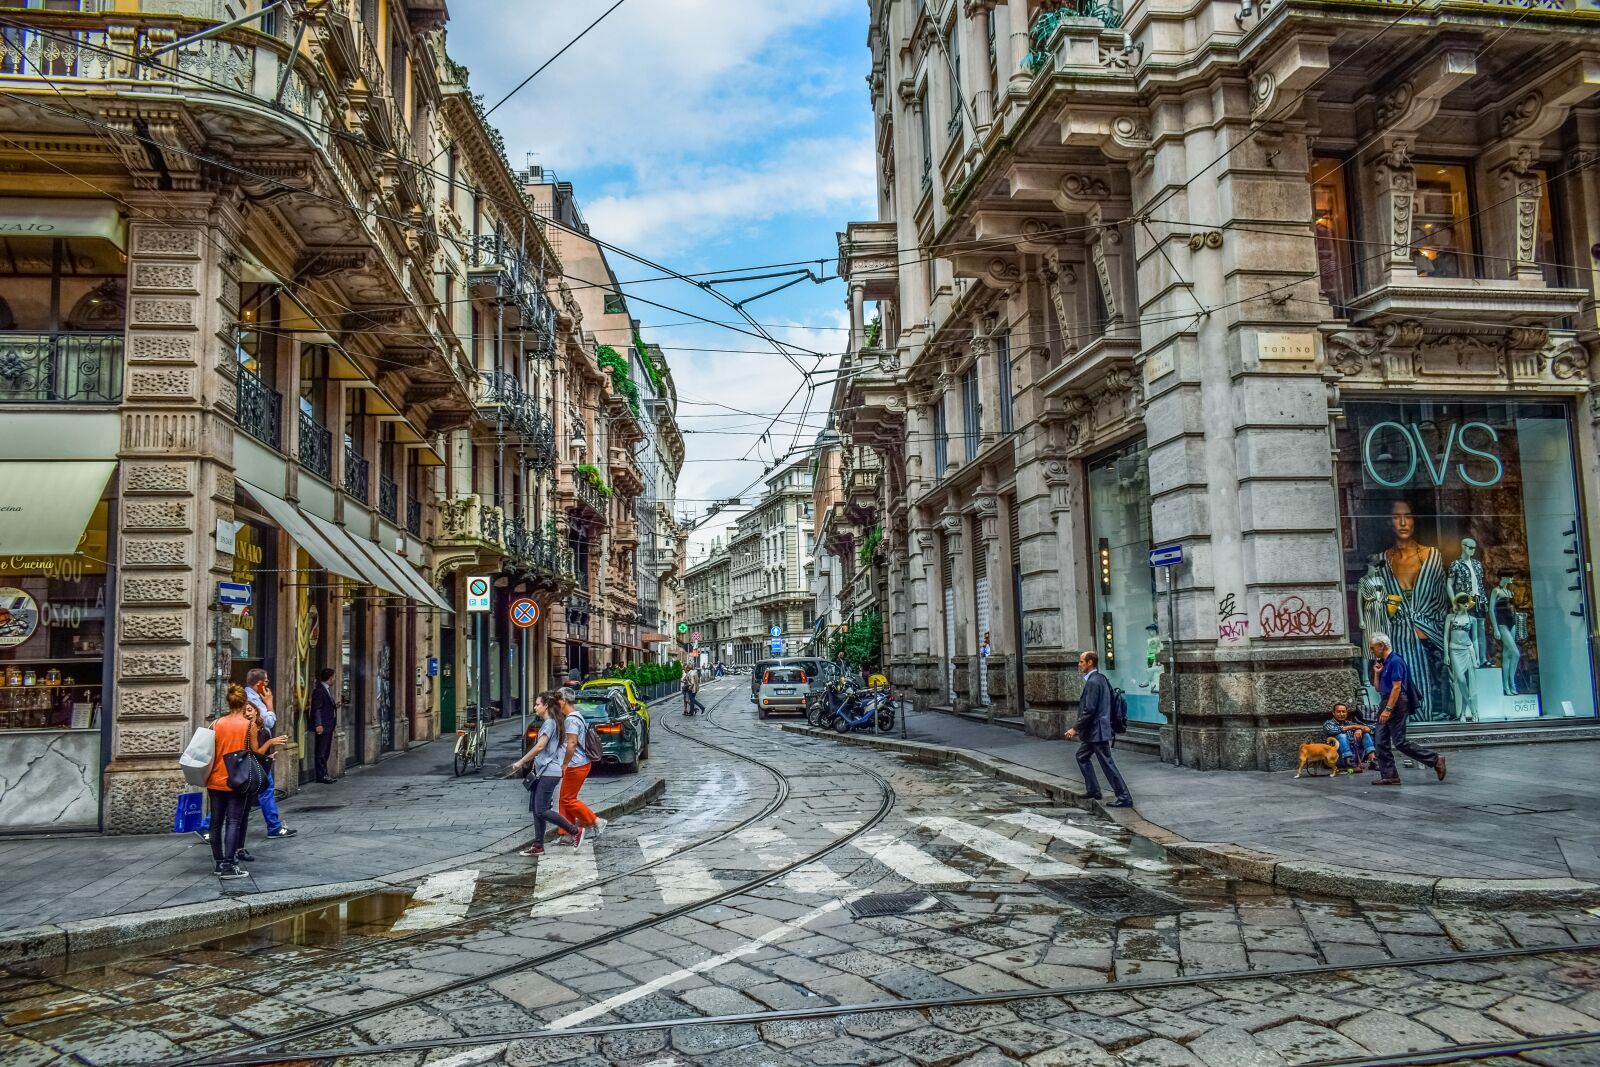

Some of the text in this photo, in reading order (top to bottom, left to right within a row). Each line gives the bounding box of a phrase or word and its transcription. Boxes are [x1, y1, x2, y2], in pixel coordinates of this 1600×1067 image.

[1263, 346, 1311, 354] TORINO
[1363, 421, 1505, 487] OVS
[10, 556, 55, 570] Cucina
